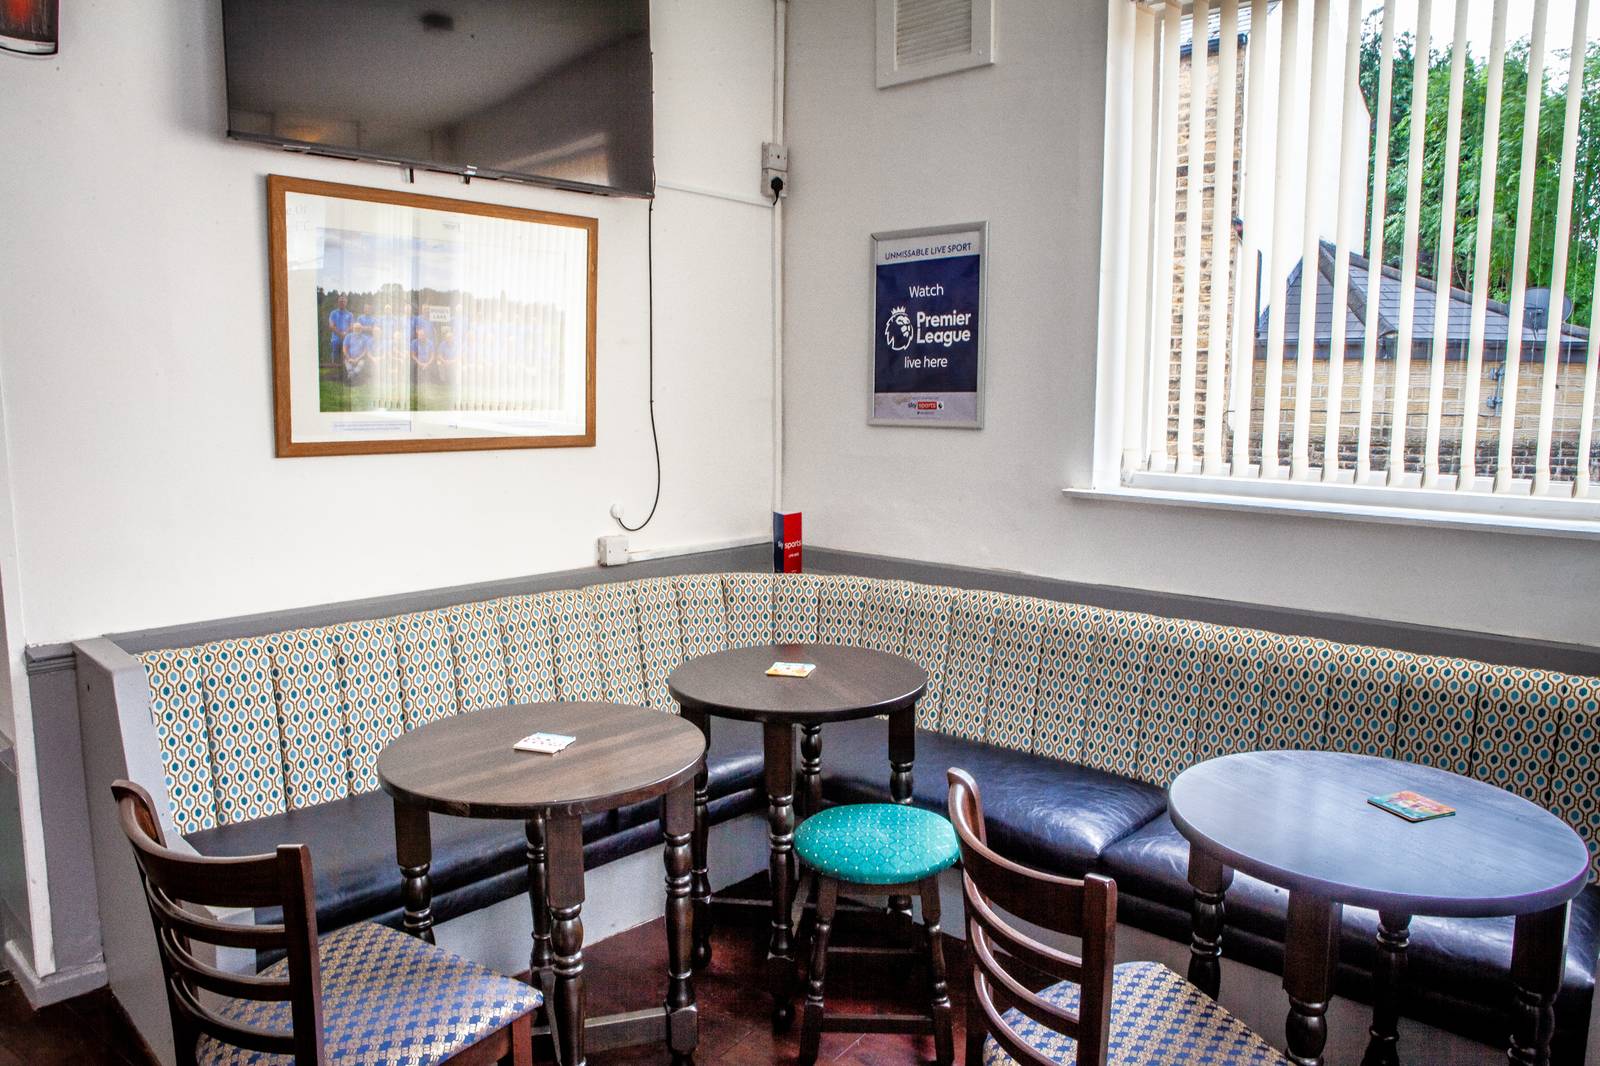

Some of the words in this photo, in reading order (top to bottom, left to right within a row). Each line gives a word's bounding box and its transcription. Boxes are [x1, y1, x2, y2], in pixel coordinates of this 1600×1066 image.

[885, 247, 929, 260] UNMISSABLE
[930, 245, 947, 255] LIVE
[948, 242, 973, 253] SPORT
[908, 283, 944, 298] Watch
[916, 309, 972, 328] Premier
[916, 329, 971, 347] League
[904, 356, 921, 368] live
[923, 356, 948, 368] here
